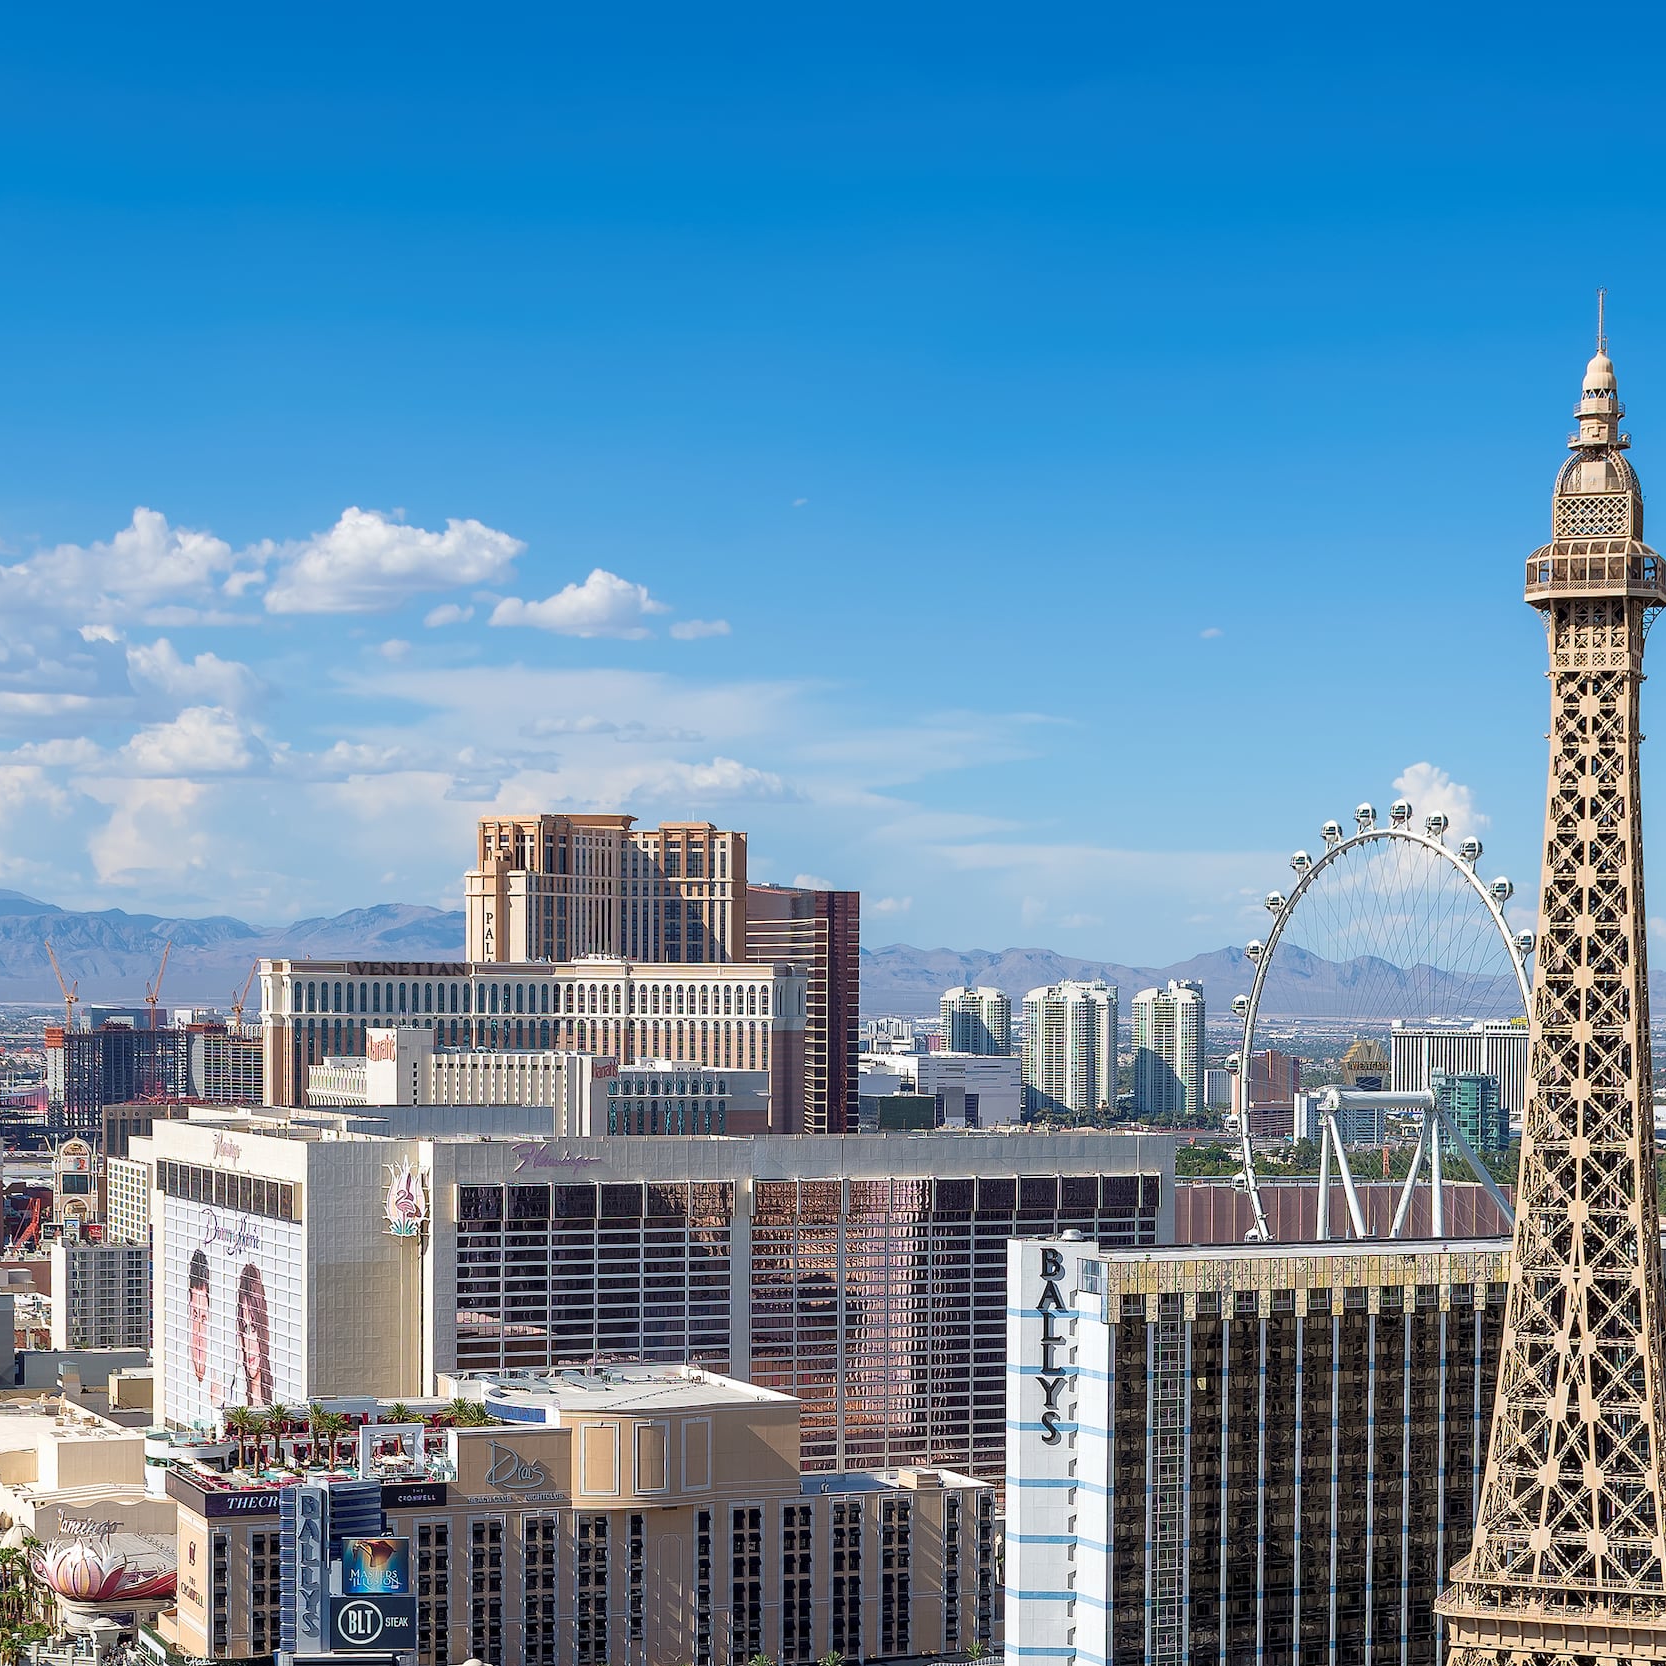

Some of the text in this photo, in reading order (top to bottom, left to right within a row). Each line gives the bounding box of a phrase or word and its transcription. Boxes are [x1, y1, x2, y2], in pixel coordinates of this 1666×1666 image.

[353, 961, 466, 976] VENETIAN
[351, 1569, 398, 1578] MASTERS
[348, 1610, 409, 1634] BLT STEAK
